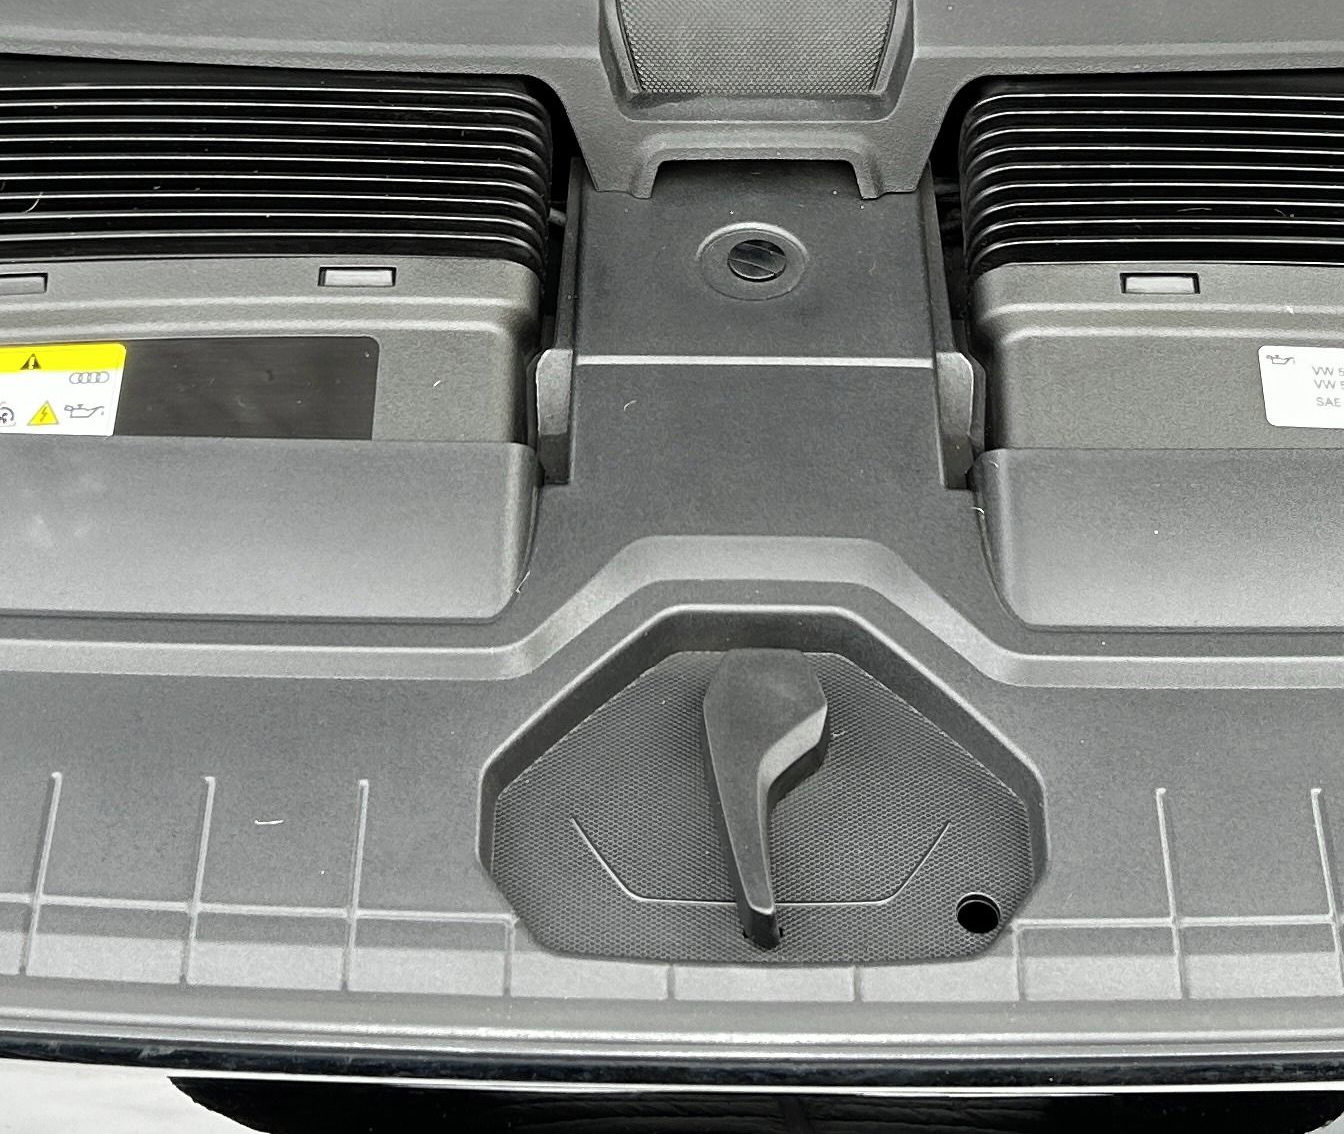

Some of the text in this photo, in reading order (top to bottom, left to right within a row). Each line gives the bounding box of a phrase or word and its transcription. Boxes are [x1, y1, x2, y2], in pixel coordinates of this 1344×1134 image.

[1312, 365, 1334, 377] VW
[1313, 379, 1336, 390] VW
[1316, 396, 1341, 408] SAE
